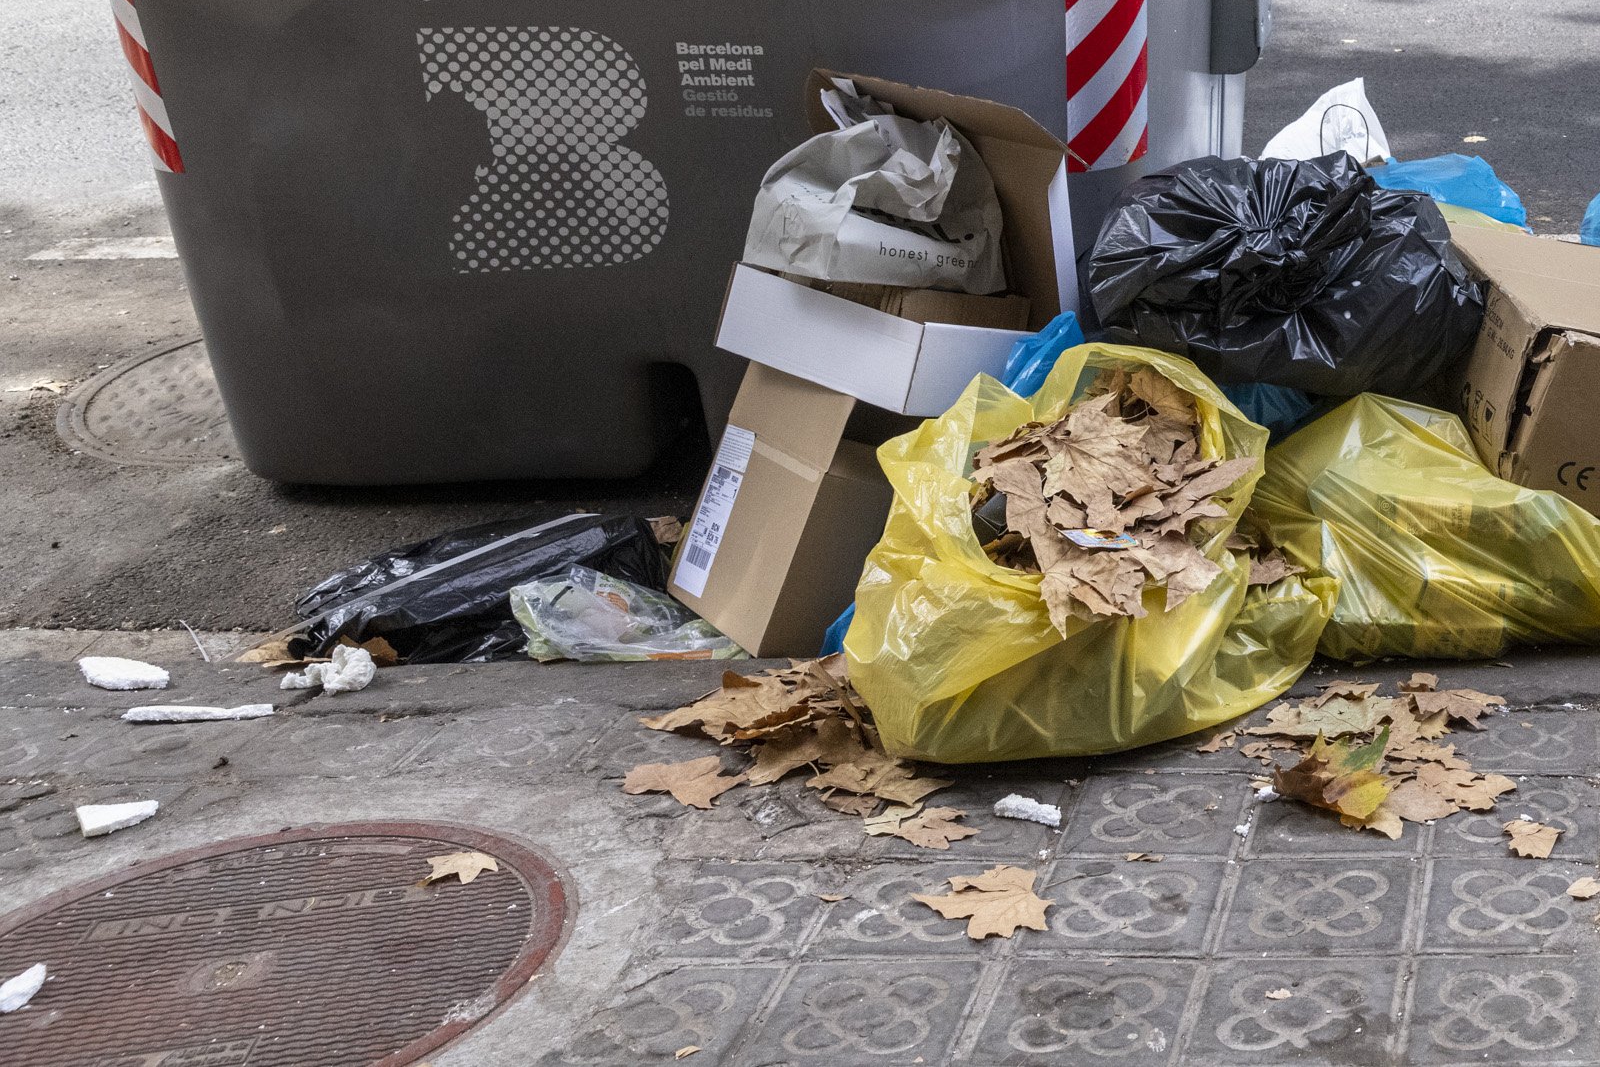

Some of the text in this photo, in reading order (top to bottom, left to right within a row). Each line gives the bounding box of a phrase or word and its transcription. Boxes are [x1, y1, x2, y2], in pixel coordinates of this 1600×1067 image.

[676, 42, 764, 56] Barcelona
[678, 57, 753, 73] pel Medi
[681, 73, 756, 87] Ambient
[682, 88, 739, 102] Gestió
[684, 104, 774, 118] de residus
[879, 241, 979, 269] honest green
